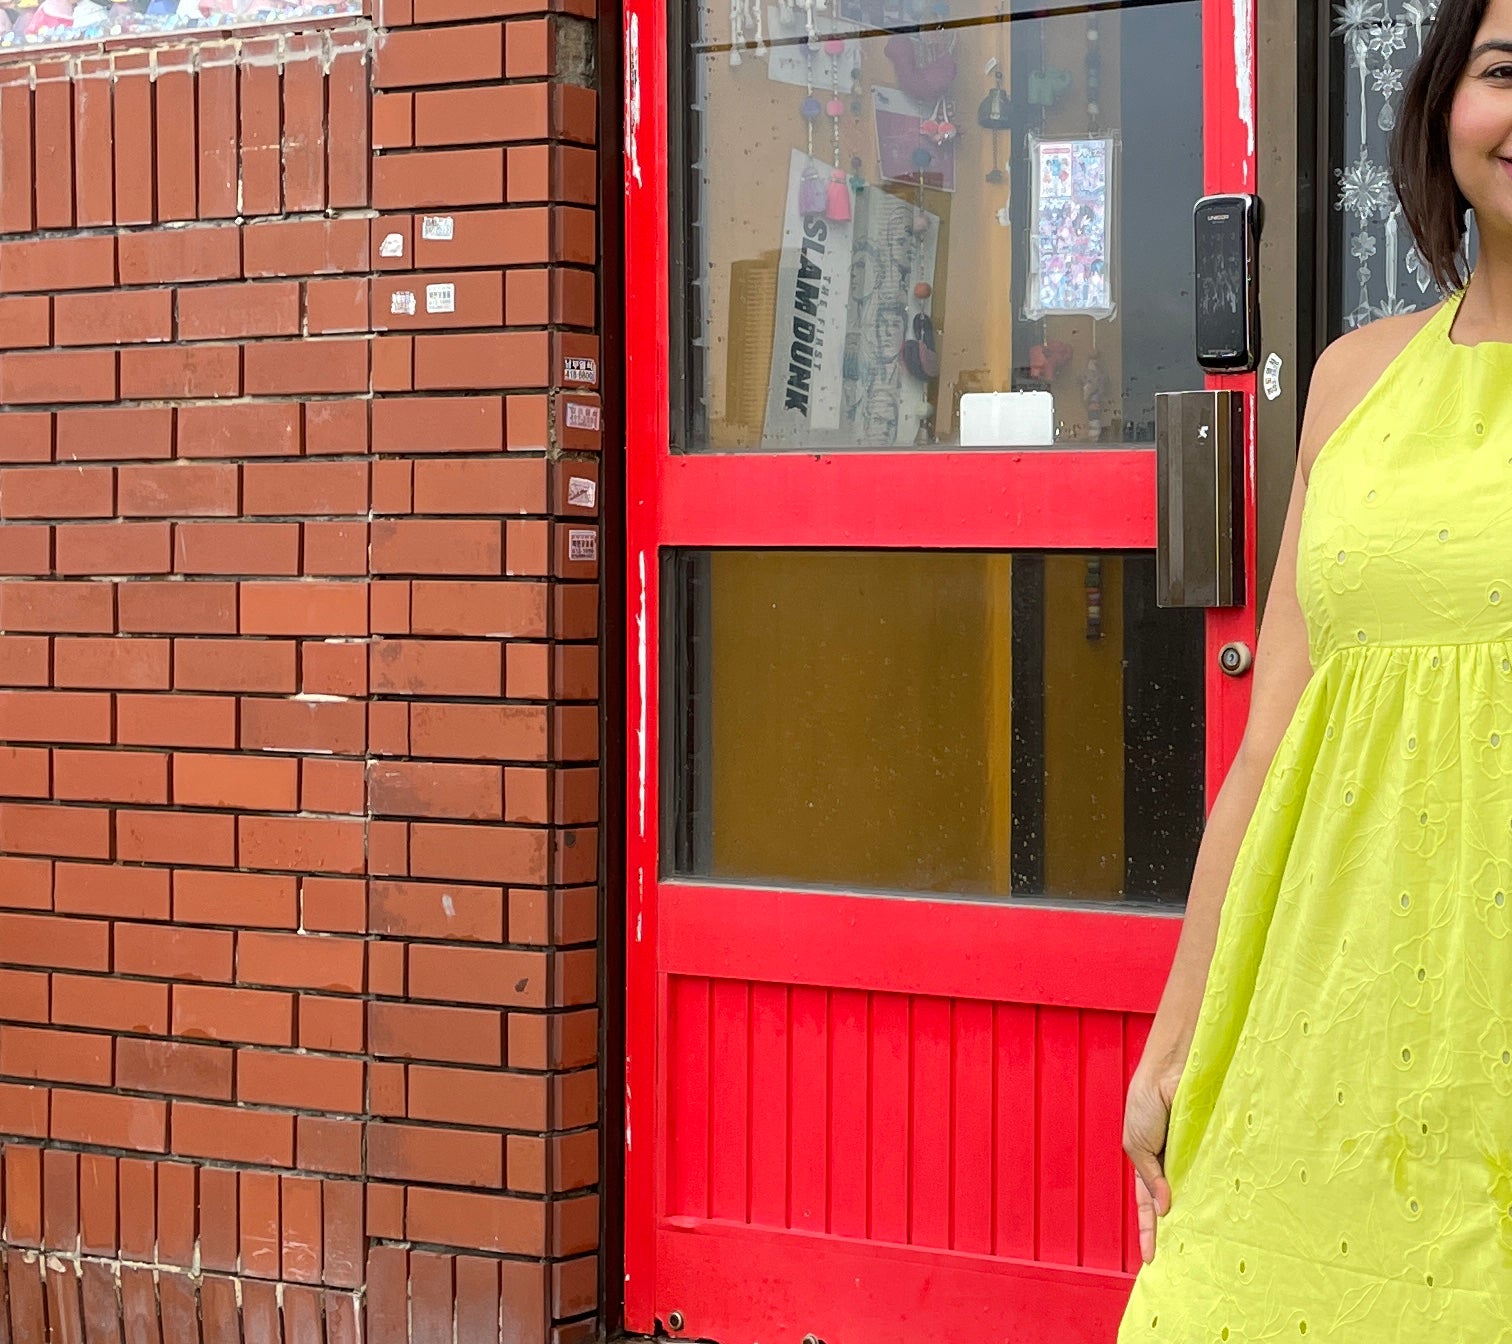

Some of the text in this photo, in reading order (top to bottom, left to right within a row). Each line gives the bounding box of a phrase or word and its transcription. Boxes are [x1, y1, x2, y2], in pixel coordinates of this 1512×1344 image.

[784, 212, 828, 418] SLAM DUNK
[813, 275, 832, 371] THE FIRST
